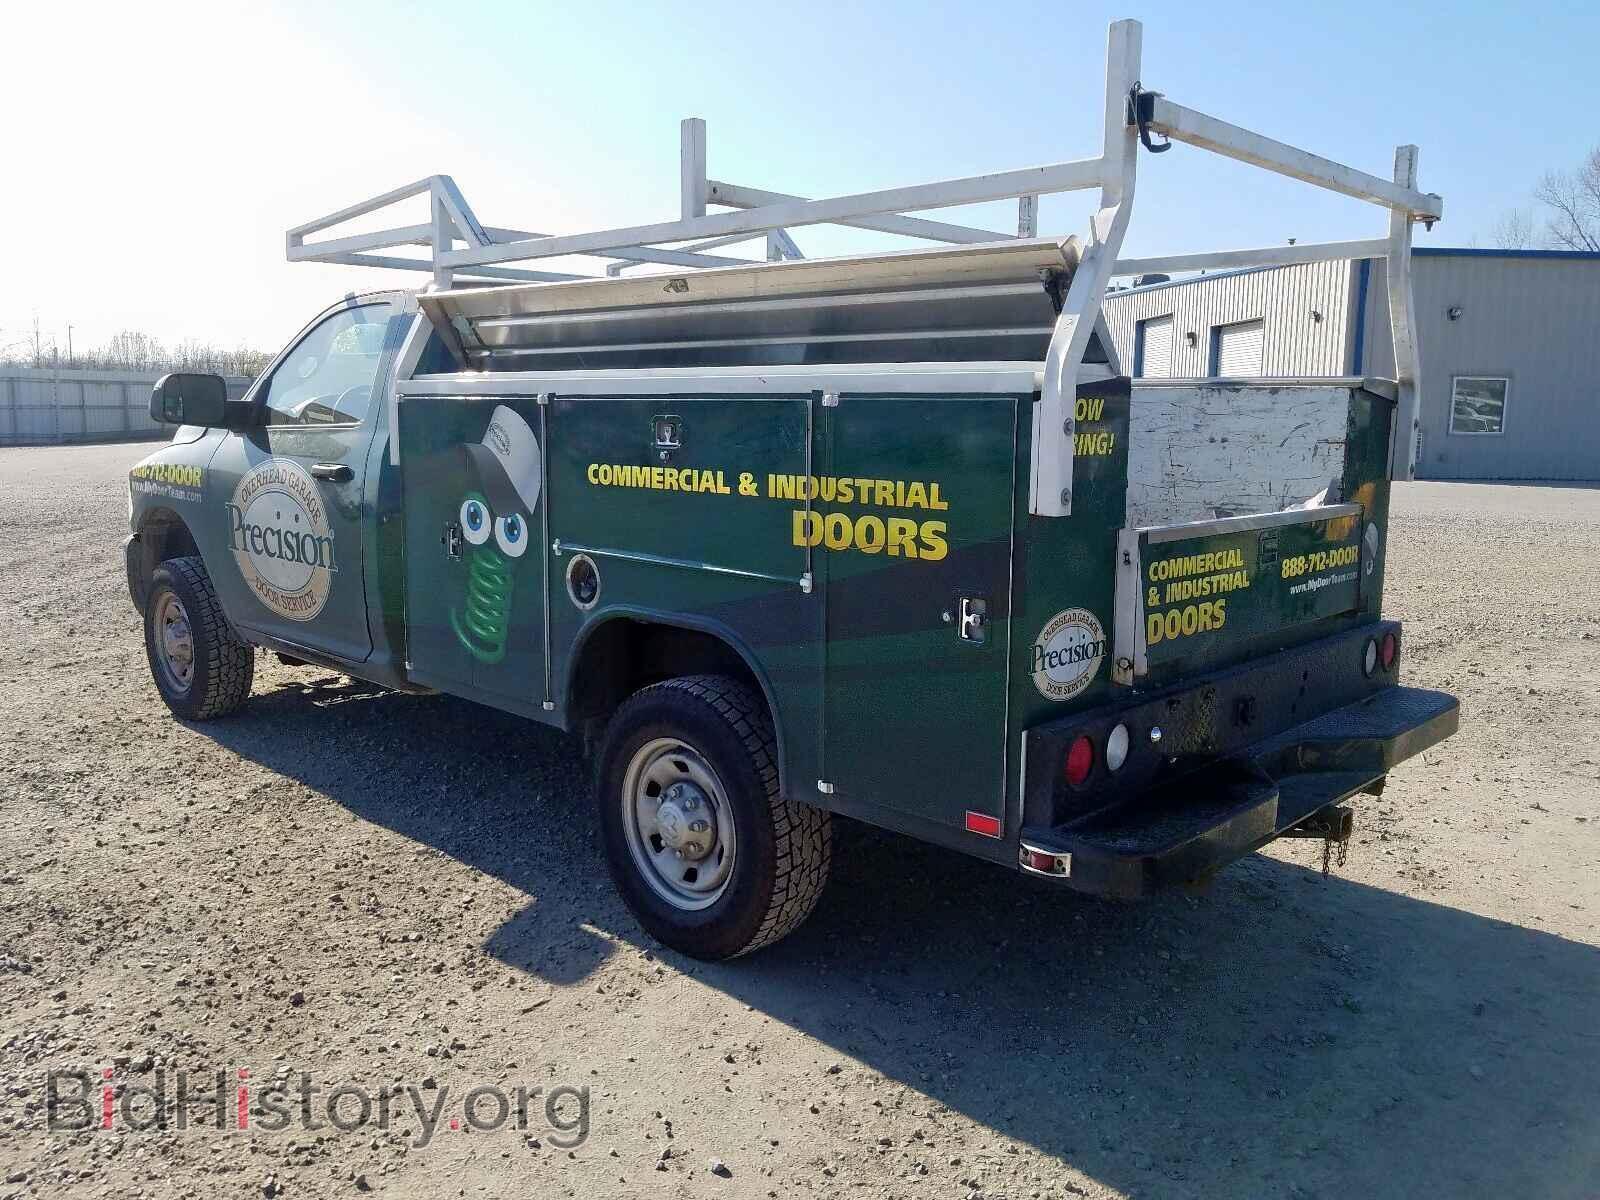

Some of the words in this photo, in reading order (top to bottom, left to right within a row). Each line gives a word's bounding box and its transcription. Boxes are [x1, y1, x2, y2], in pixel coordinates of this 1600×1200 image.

[1074, 398, 1105, 421] OW
[1072, 432, 1115, 456] RING!
[241, 467, 288, 504] OVERHEAD
[287, 472, 322, 524] GARAGE
[587, 463, 731, 494] COMMERCIAL
[738, 472, 760, 497] &
[768, 473, 949, 510] INDUSTRIAL
[225, 501, 338, 573] Precision
[792, 510, 949, 561] DOORS
[1149, 548, 1244, 582] COMMERCIAL
[1281, 545, 1359, 579] 888-712-DOOR
[255, 576, 283, 607] DOOR
[281, 589, 317, 612] SERVICE
[1147, 586, 1161, 607] &
[1165, 570, 1250, 604] INDUSTRIAL
[1044, 612, 1077, 640] OVERHEAD
[1147, 598, 1226, 645] DOORS
[1028, 633, 1107, 676] Precision
